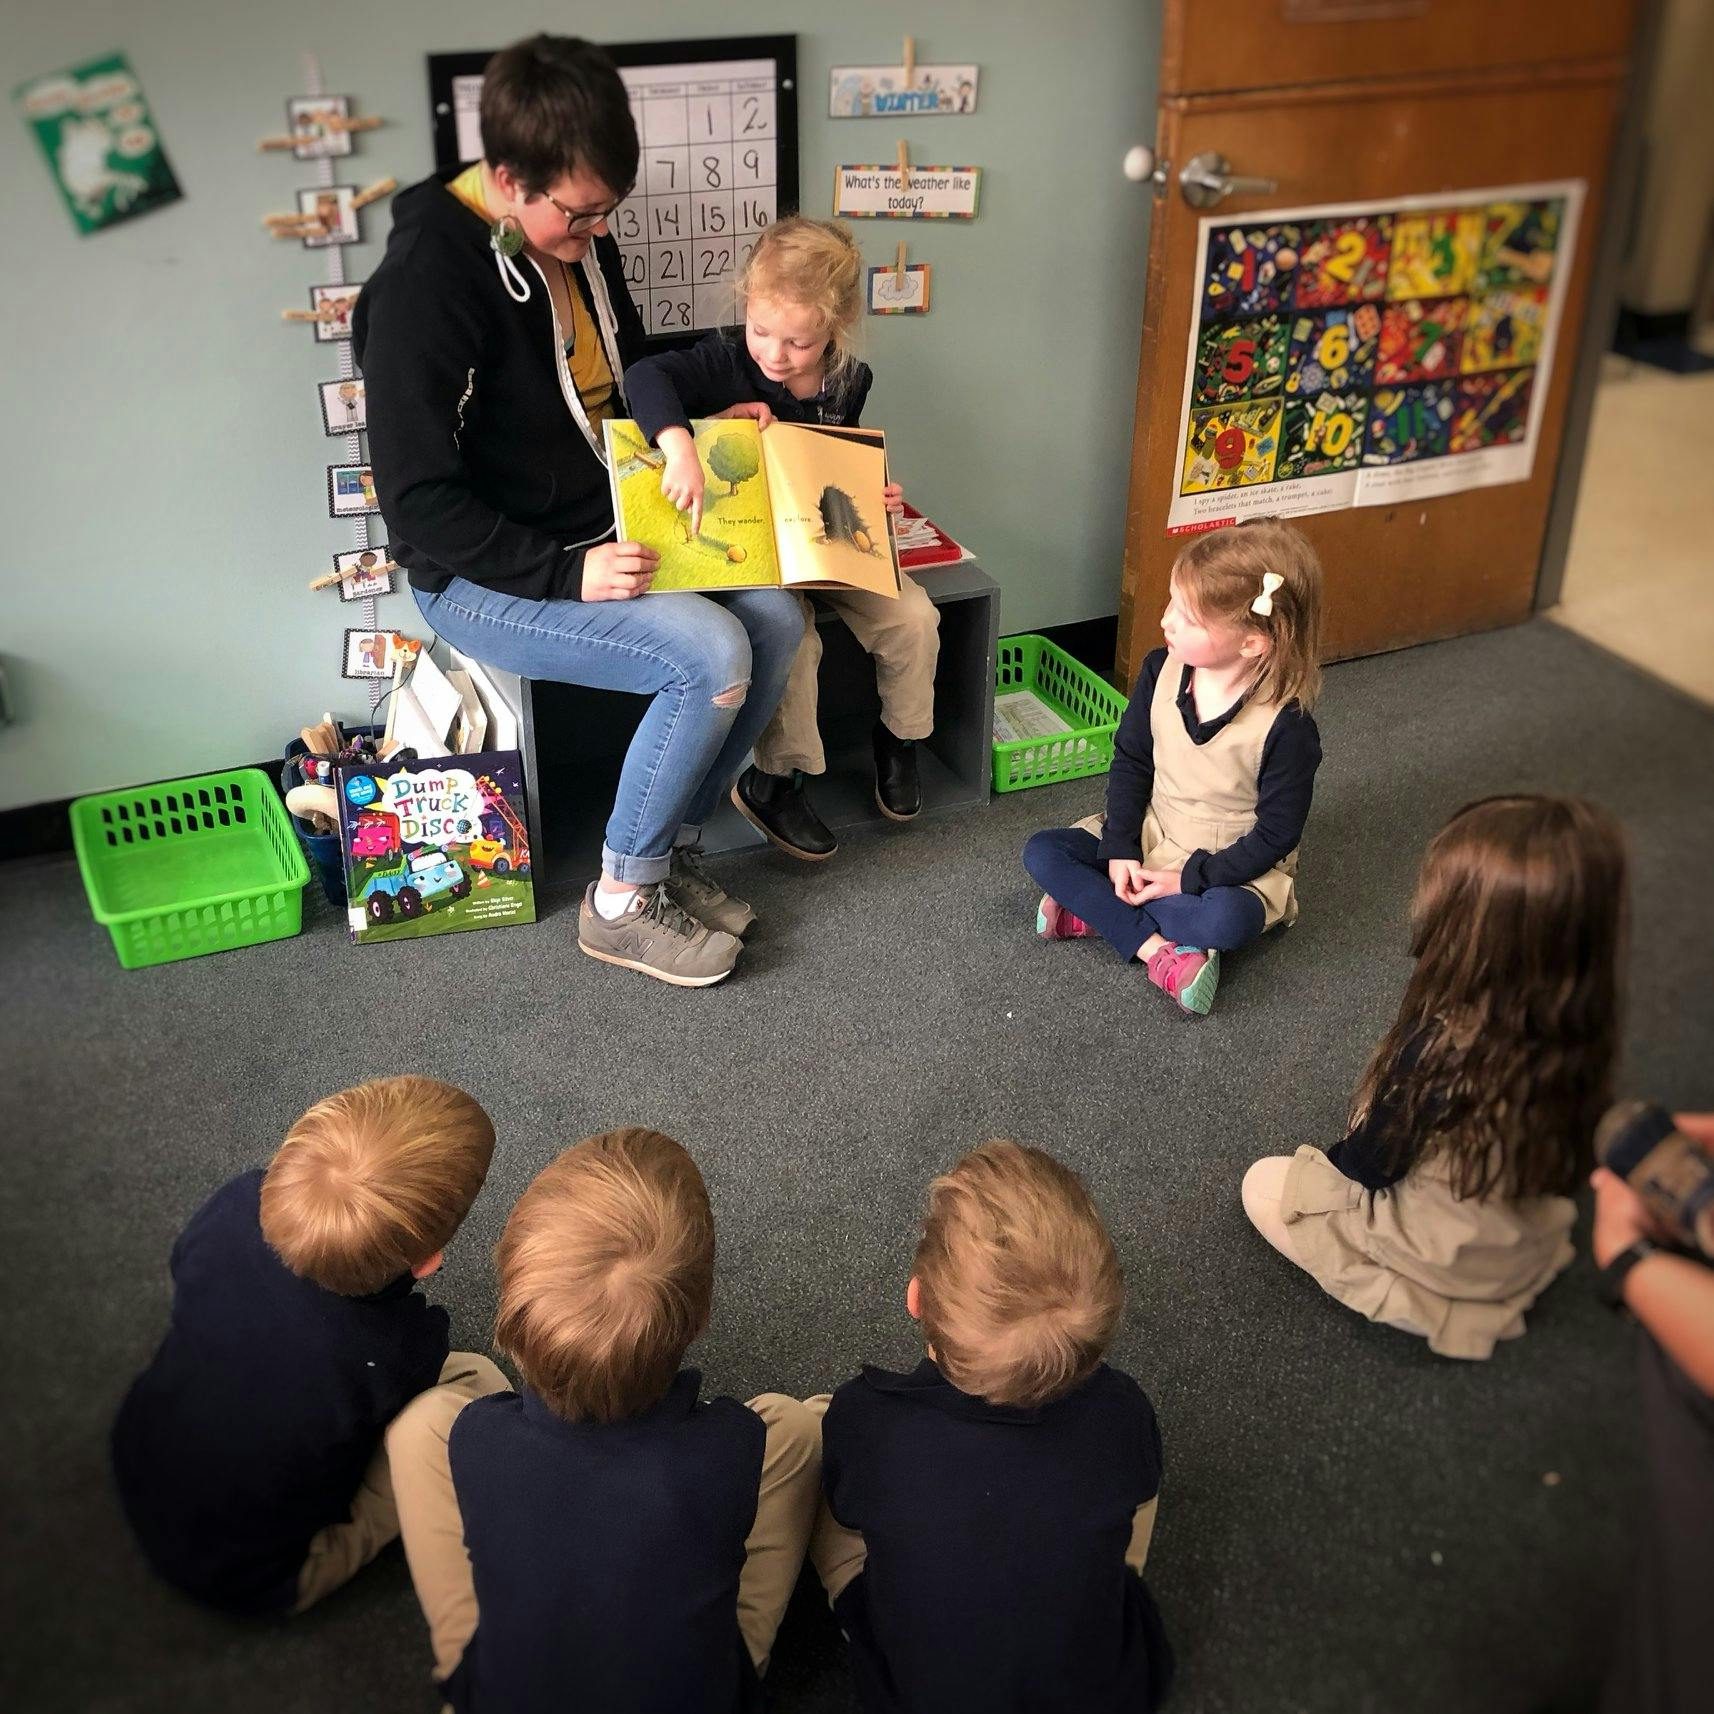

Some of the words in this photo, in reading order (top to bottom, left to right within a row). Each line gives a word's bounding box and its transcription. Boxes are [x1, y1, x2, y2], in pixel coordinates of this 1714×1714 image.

[706, 105, 713, 136] 1
[742, 96, 768, 133] 2
[656, 160, 676, 188] 7
[703, 156, 721, 188] 8
[743, 149, 760, 180] 9
[845, 175, 880, 189] What's
[884, 175, 901, 189] the
[953, 177, 971, 190] like
[615, 209, 640, 239] 13
[656, 204, 679, 236] 14
[701, 203, 725, 233] 15
[744, 199, 768, 229] 16
[888, 196, 924, 217] today?
[660, 250, 685, 282] 21
[700, 249, 733, 279] 22
[1325, 230, 1367, 283] 2
[657, 299, 691, 327] 28
[1222, 338, 1257, 384] 5
[1318, 323, 1350, 370] 6
[1304, 410, 1354, 457] 10
[717, 517, 736, 527] They
[1179, 518, 1235, 533] SCHOLASTIC
[391, 778, 458, 799] Dump
[394, 793, 469, 817] Truck
